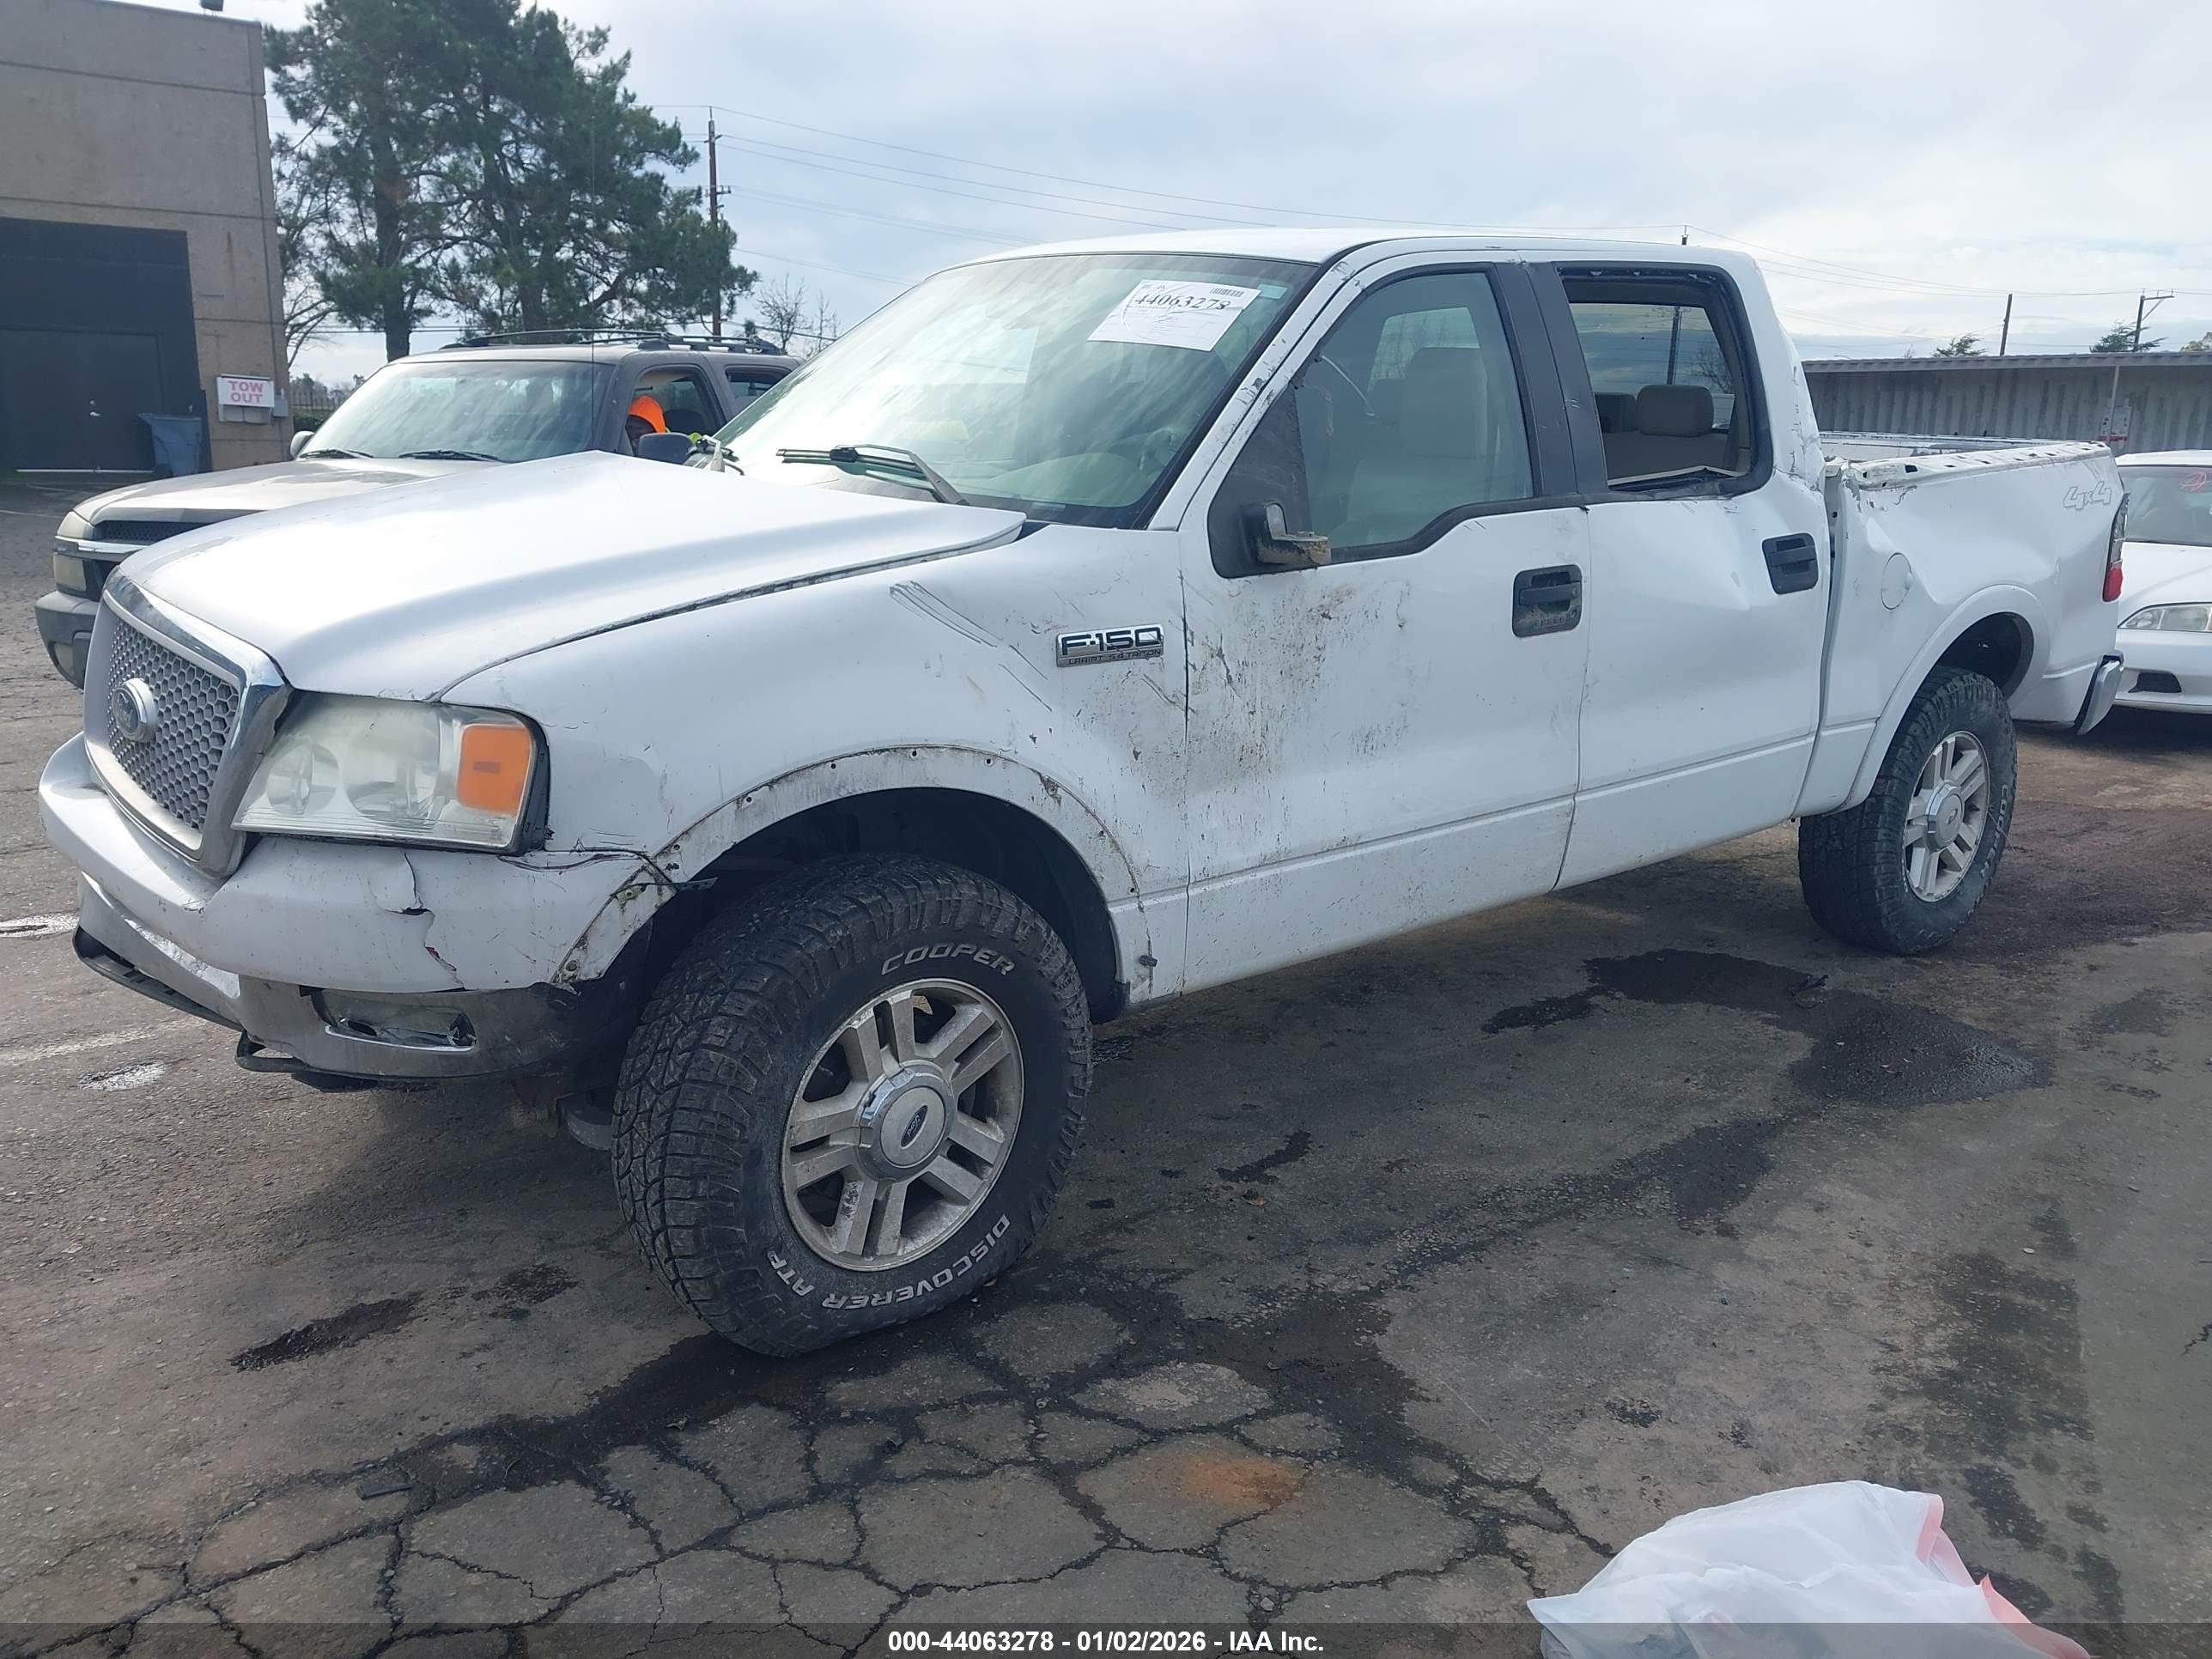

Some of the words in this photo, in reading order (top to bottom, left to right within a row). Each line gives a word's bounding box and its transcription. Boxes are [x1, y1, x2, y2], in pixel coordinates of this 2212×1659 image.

[1134, 293, 1231, 310] 44063278
[228, 380, 263, 392] TOW
[230, 392, 263, 404] OUT
[2062, 480, 2112, 510] 4x4
[1060, 626, 1162, 656] F-150
[881, 944, 1016, 976] COOPER
[821, 1213, 1011, 1310] DISCOVERER
